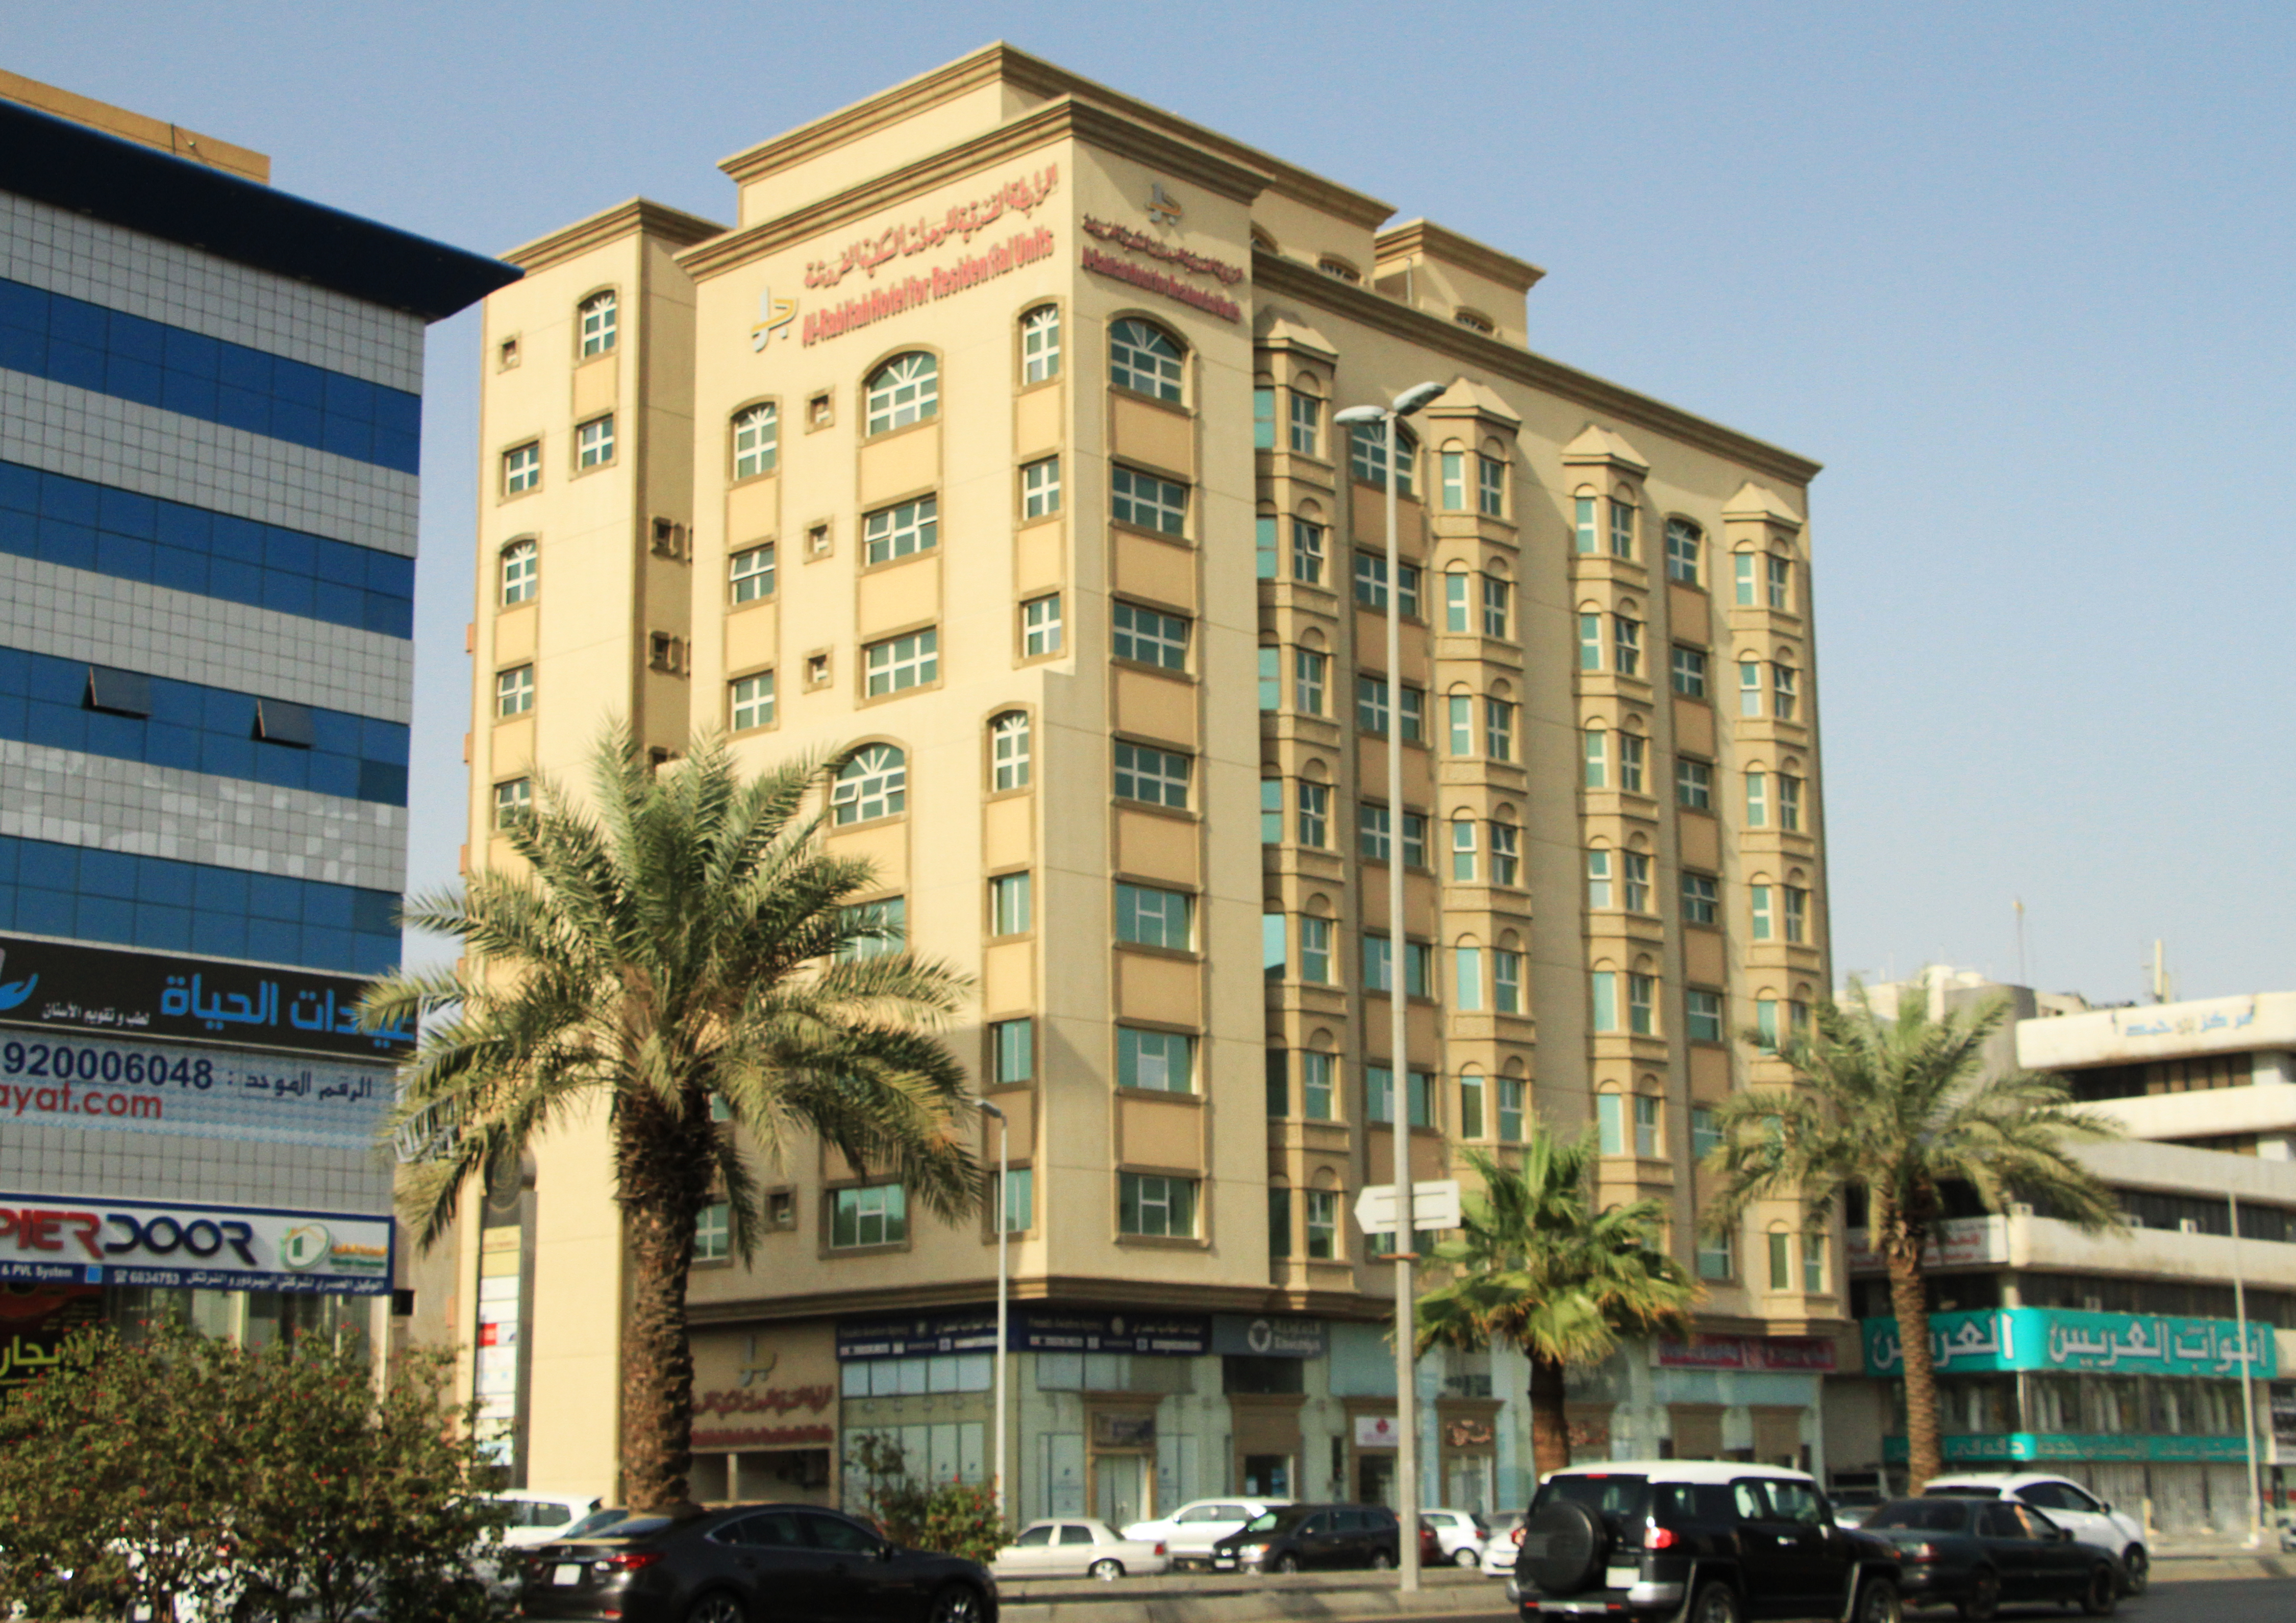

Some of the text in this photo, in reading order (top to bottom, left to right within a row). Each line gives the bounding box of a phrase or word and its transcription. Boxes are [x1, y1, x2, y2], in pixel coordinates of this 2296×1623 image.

[160, 973, 279, 1030] الحياة
[4, 1041, 214, 1090] 920006048
[245, 1070, 312, 1097] الموحد
[318, 1075, 372, 1102] الرقم
[36, 1265, 73, 1280] System
[1873, 1313, 2014, 1370] العرس
[2049, 1320, 2170, 1367] العريس
